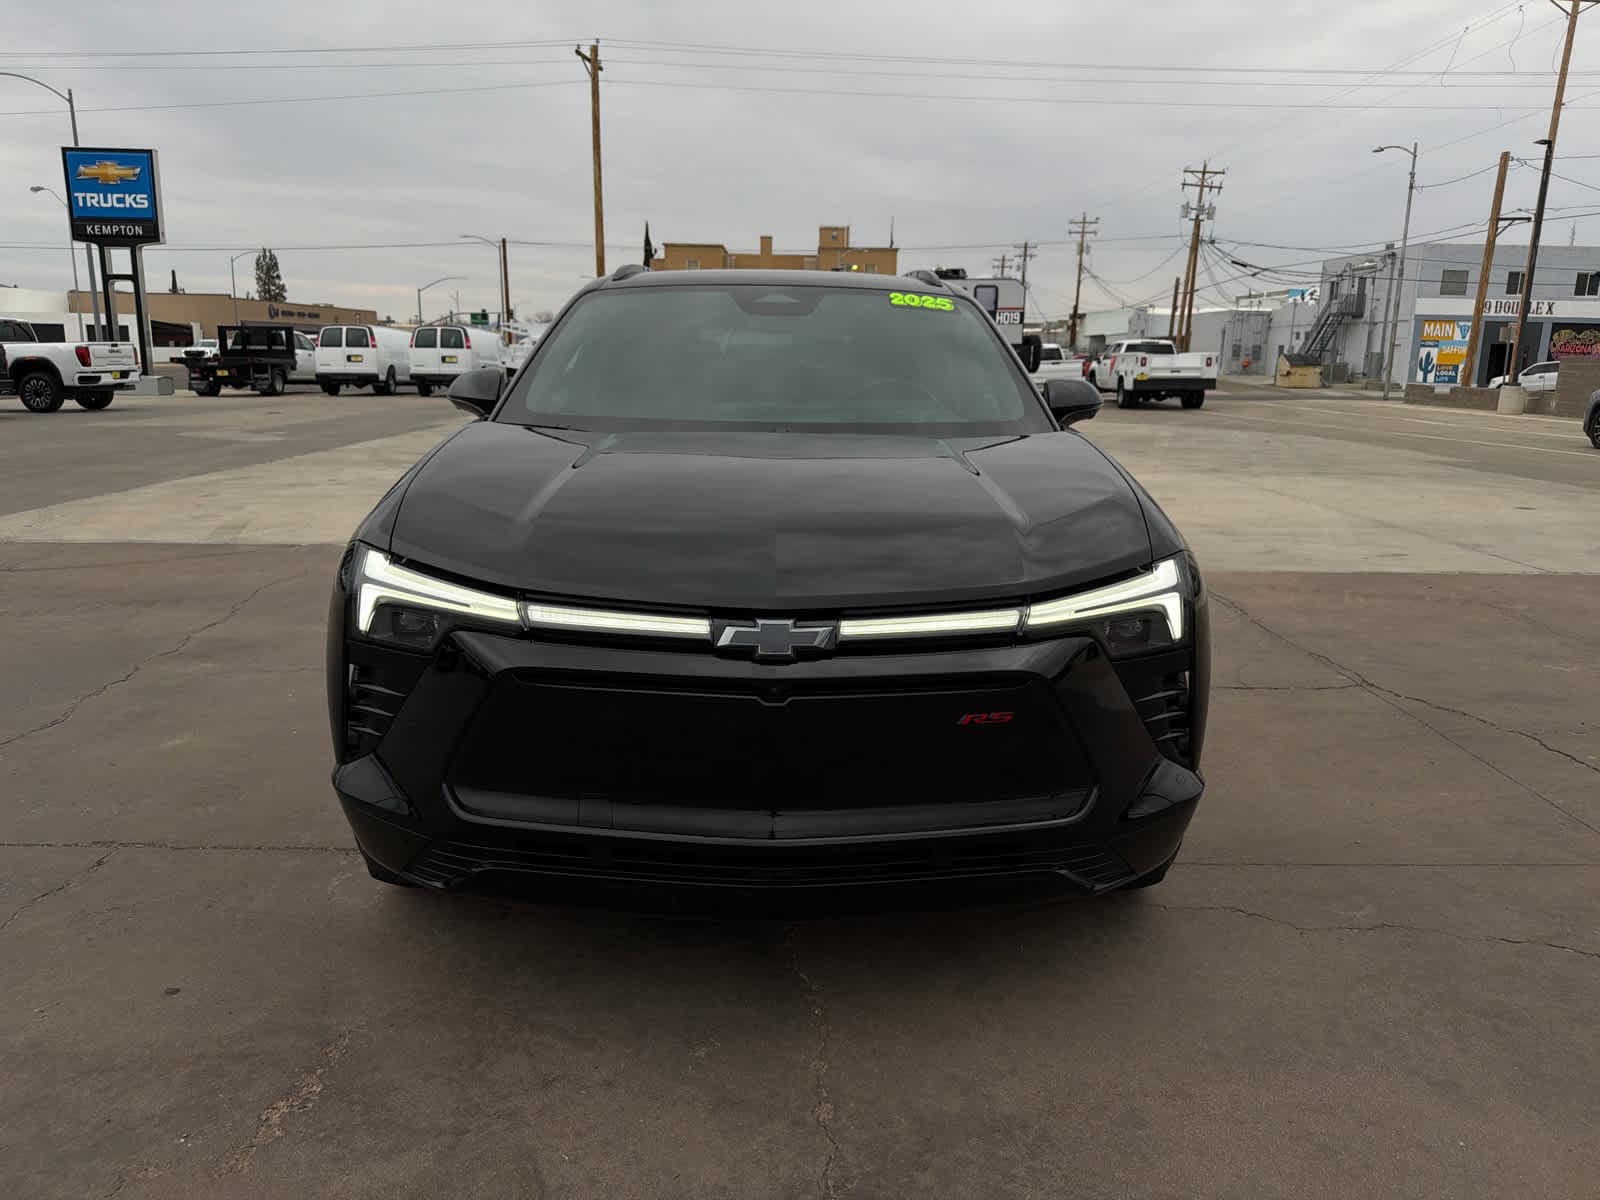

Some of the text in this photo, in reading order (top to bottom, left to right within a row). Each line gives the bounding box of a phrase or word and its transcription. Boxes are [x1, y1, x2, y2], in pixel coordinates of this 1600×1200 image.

[74, 192, 149, 209] TRUCKS
[86, 224, 143, 236] KEMPTON
[889, 292, 955, 311] 2025
[1494, 301, 1543, 315] DOULE
[1423, 322, 1453, 337] MAIN
[956, 711, 1015, 725] RS
